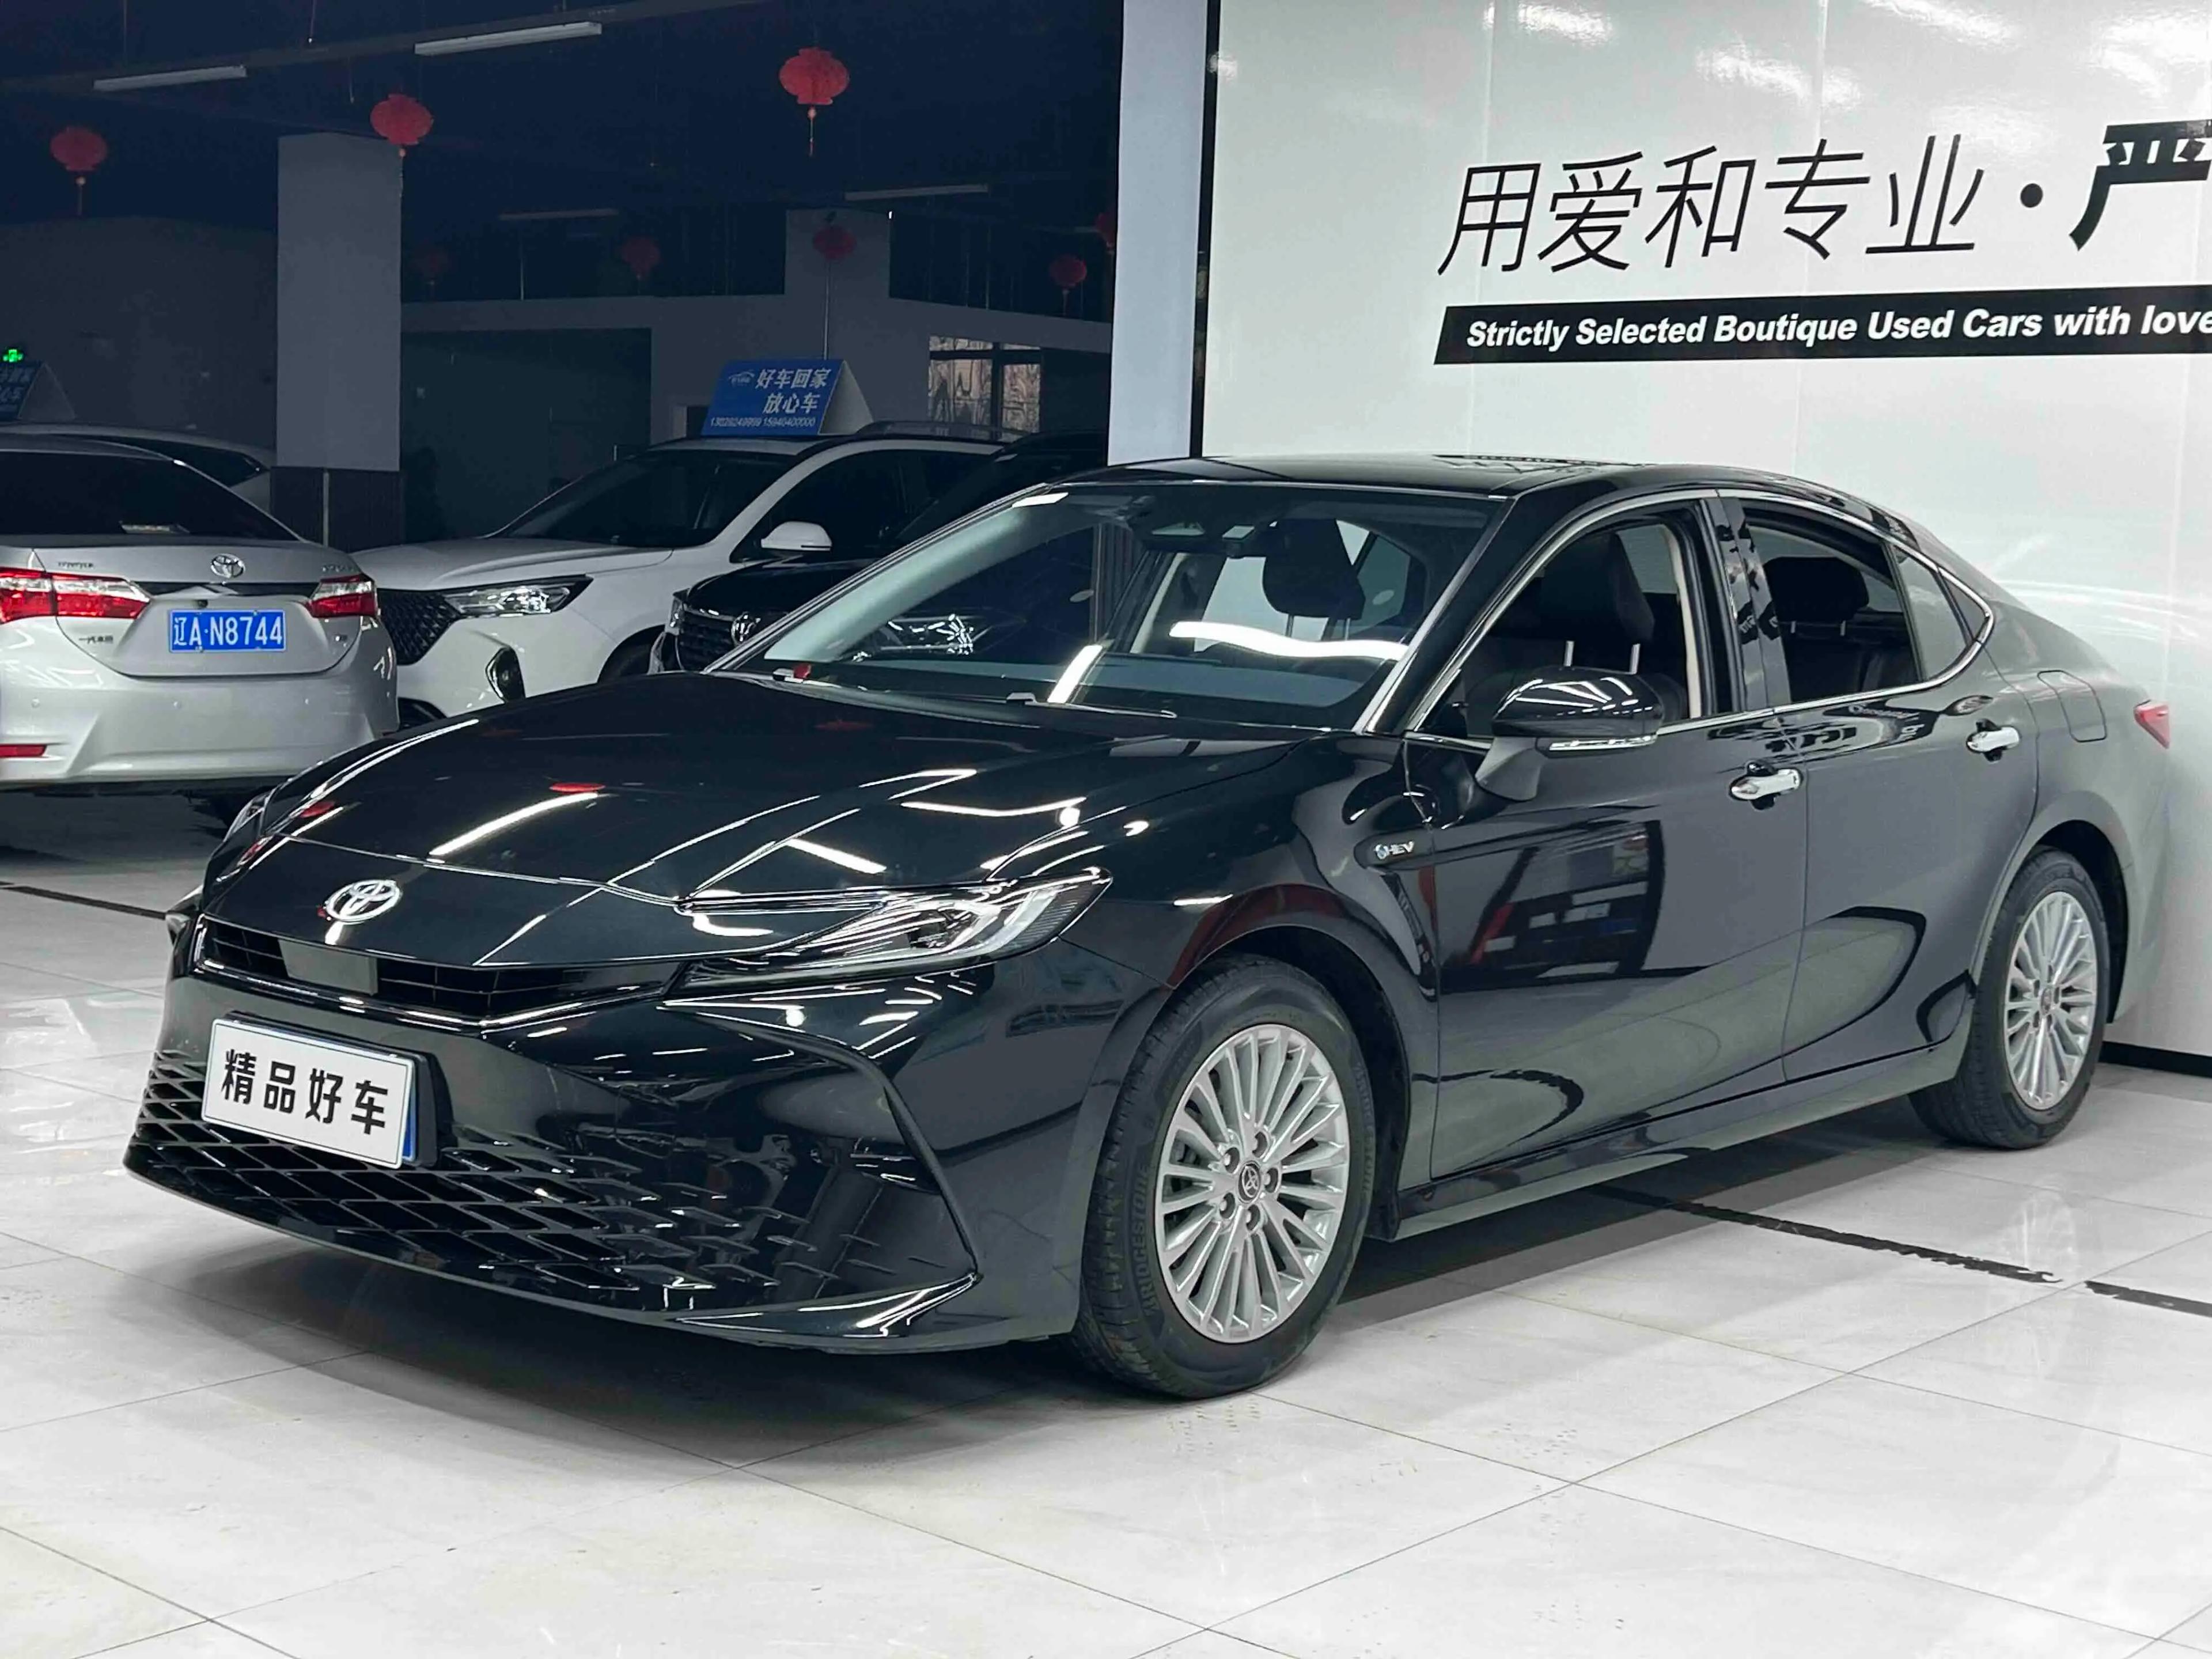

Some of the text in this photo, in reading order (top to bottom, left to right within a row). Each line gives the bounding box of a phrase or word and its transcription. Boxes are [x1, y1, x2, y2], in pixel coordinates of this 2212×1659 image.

[1467, 320, 1570, 352] Strictly
[1575, 316, 1707, 345] Selected
[1714, 313, 1858, 347] Boutique
[1868, 309, 1955, 339] Used
[1963, 308, 2043, 338] Cars
[2054, 305, 2131, 336] with
[755, 368, 832, 389] 好车回家
[762, 392, 821, 414] 放心车
[221, 1048, 388, 1134] 精品好车
